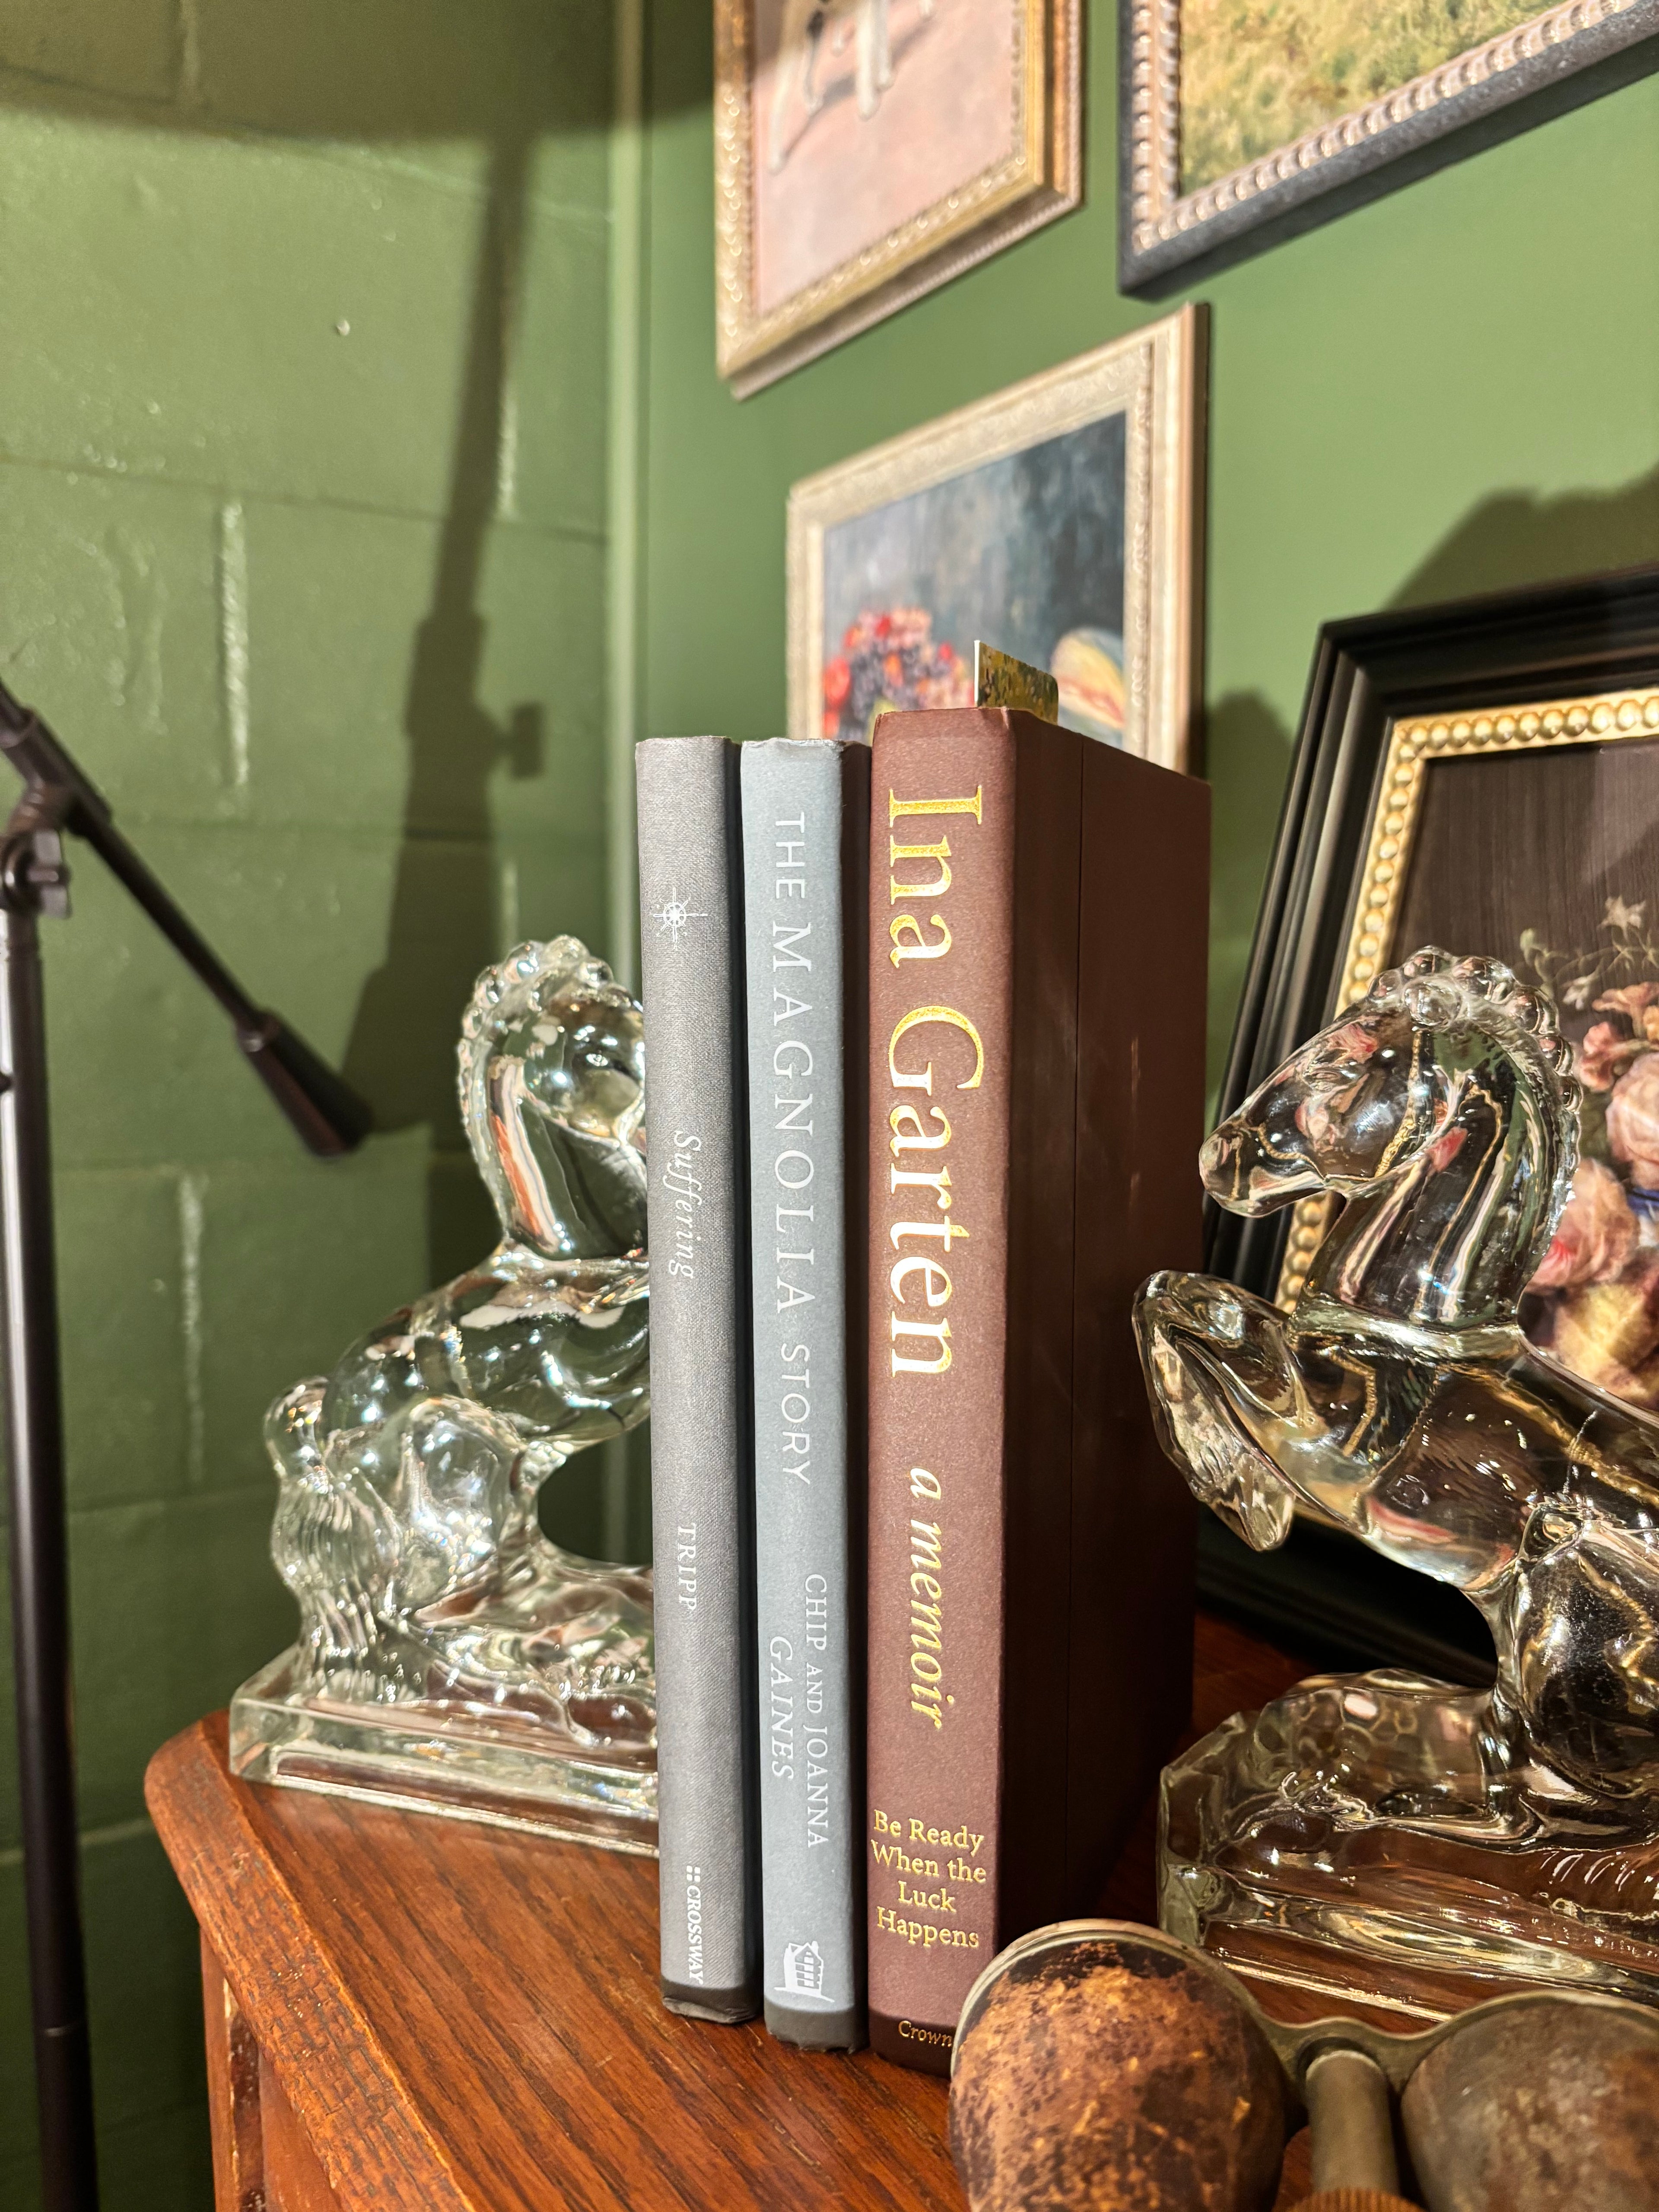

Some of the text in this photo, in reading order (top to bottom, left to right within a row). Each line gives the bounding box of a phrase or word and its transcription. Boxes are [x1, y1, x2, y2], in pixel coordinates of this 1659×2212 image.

[888, 785, 984, 1377] Ina Garten
[772, 812, 815, 1485] THE MAGNOLIA STORY
[663, 1130, 702, 1278] Suffering
[677, 1522, 696, 1611] TRIPP
[910, 1467, 954, 1729] a memoir
[769, 1636, 794, 1780] GAINES
[803, 1573, 829, 1848] CHIP AND JOANNA
[871, 1840, 987, 1884] When the
[874, 1809, 984, 1856] Be Ready
[686, 1885, 703, 1984] CROSSWAY
[877, 1907, 979, 1948] Happens
[898, 1880, 956, 1913] Luck
[898, 2021, 953, 2048] Crown
